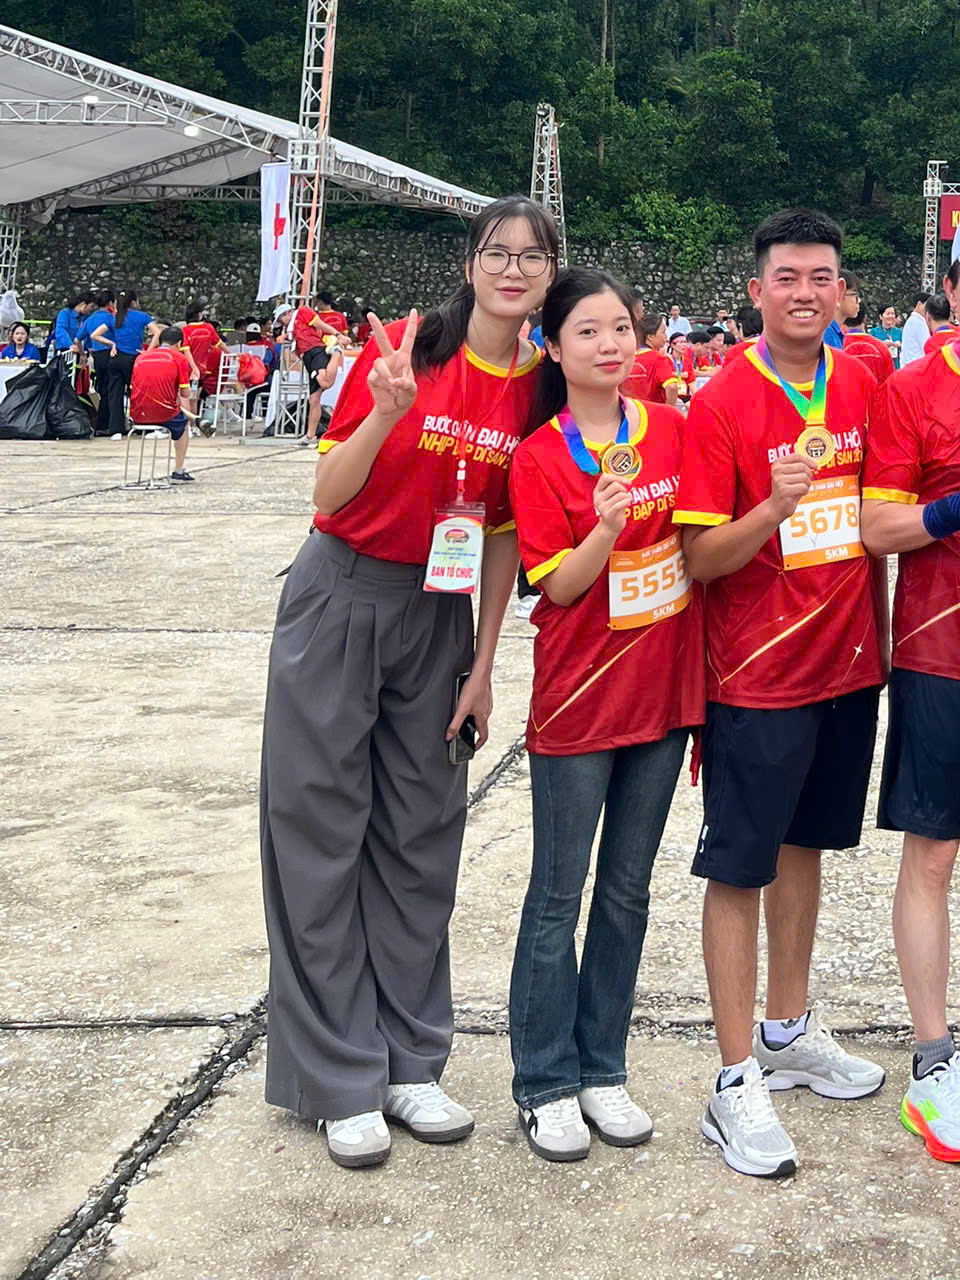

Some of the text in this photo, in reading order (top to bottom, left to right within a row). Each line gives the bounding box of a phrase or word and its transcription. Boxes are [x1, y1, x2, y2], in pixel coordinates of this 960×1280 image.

[417, 431, 455, 456] NHỊP
[476, 427, 504, 450] ĐẠI
[649, 476, 674, 499] ĐẠI
[790, 502, 858, 538] 5678
[824, 545, 849, 560] 5KM
[431, 566, 445, 577] BAN
[455, 564, 475, 579] CHỨC
[621, 558, 685, 602] 5555
[652, 602, 675, 620] 5KM
